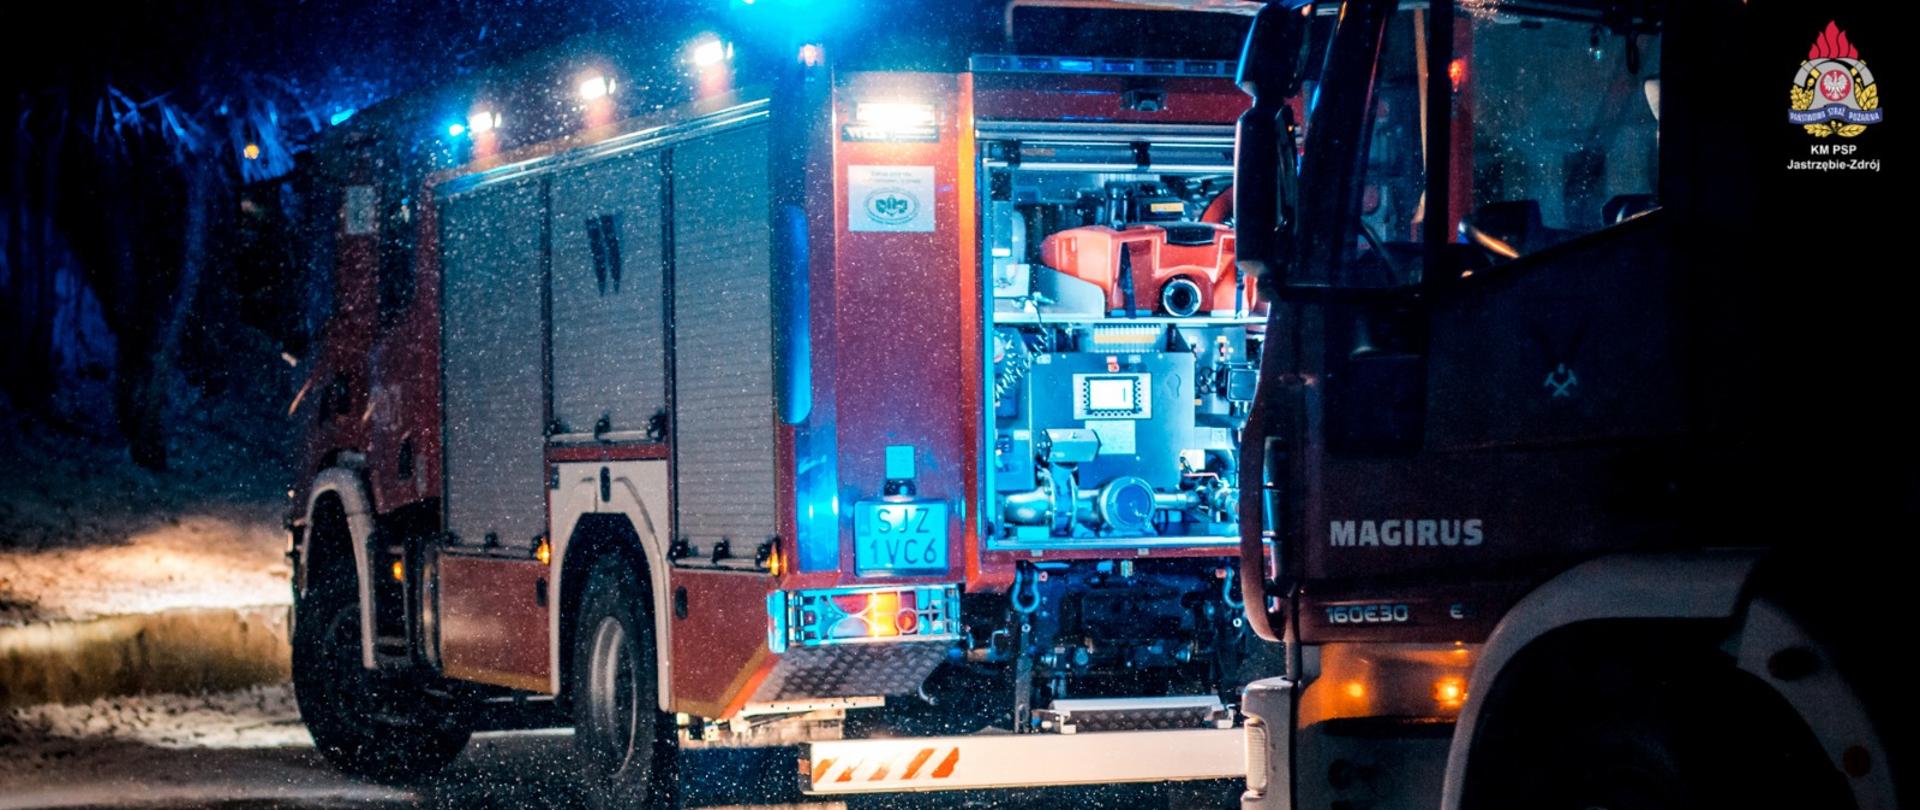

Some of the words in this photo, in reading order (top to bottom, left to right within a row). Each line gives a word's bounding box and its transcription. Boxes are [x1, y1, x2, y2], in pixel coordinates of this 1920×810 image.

[877, 507, 930, 534] SJZ
[1329, 518, 1484, 547] MAGIRUS
[869, 538, 937, 565] 1VC6
[1326, 604, 1409, 624] 160E30
